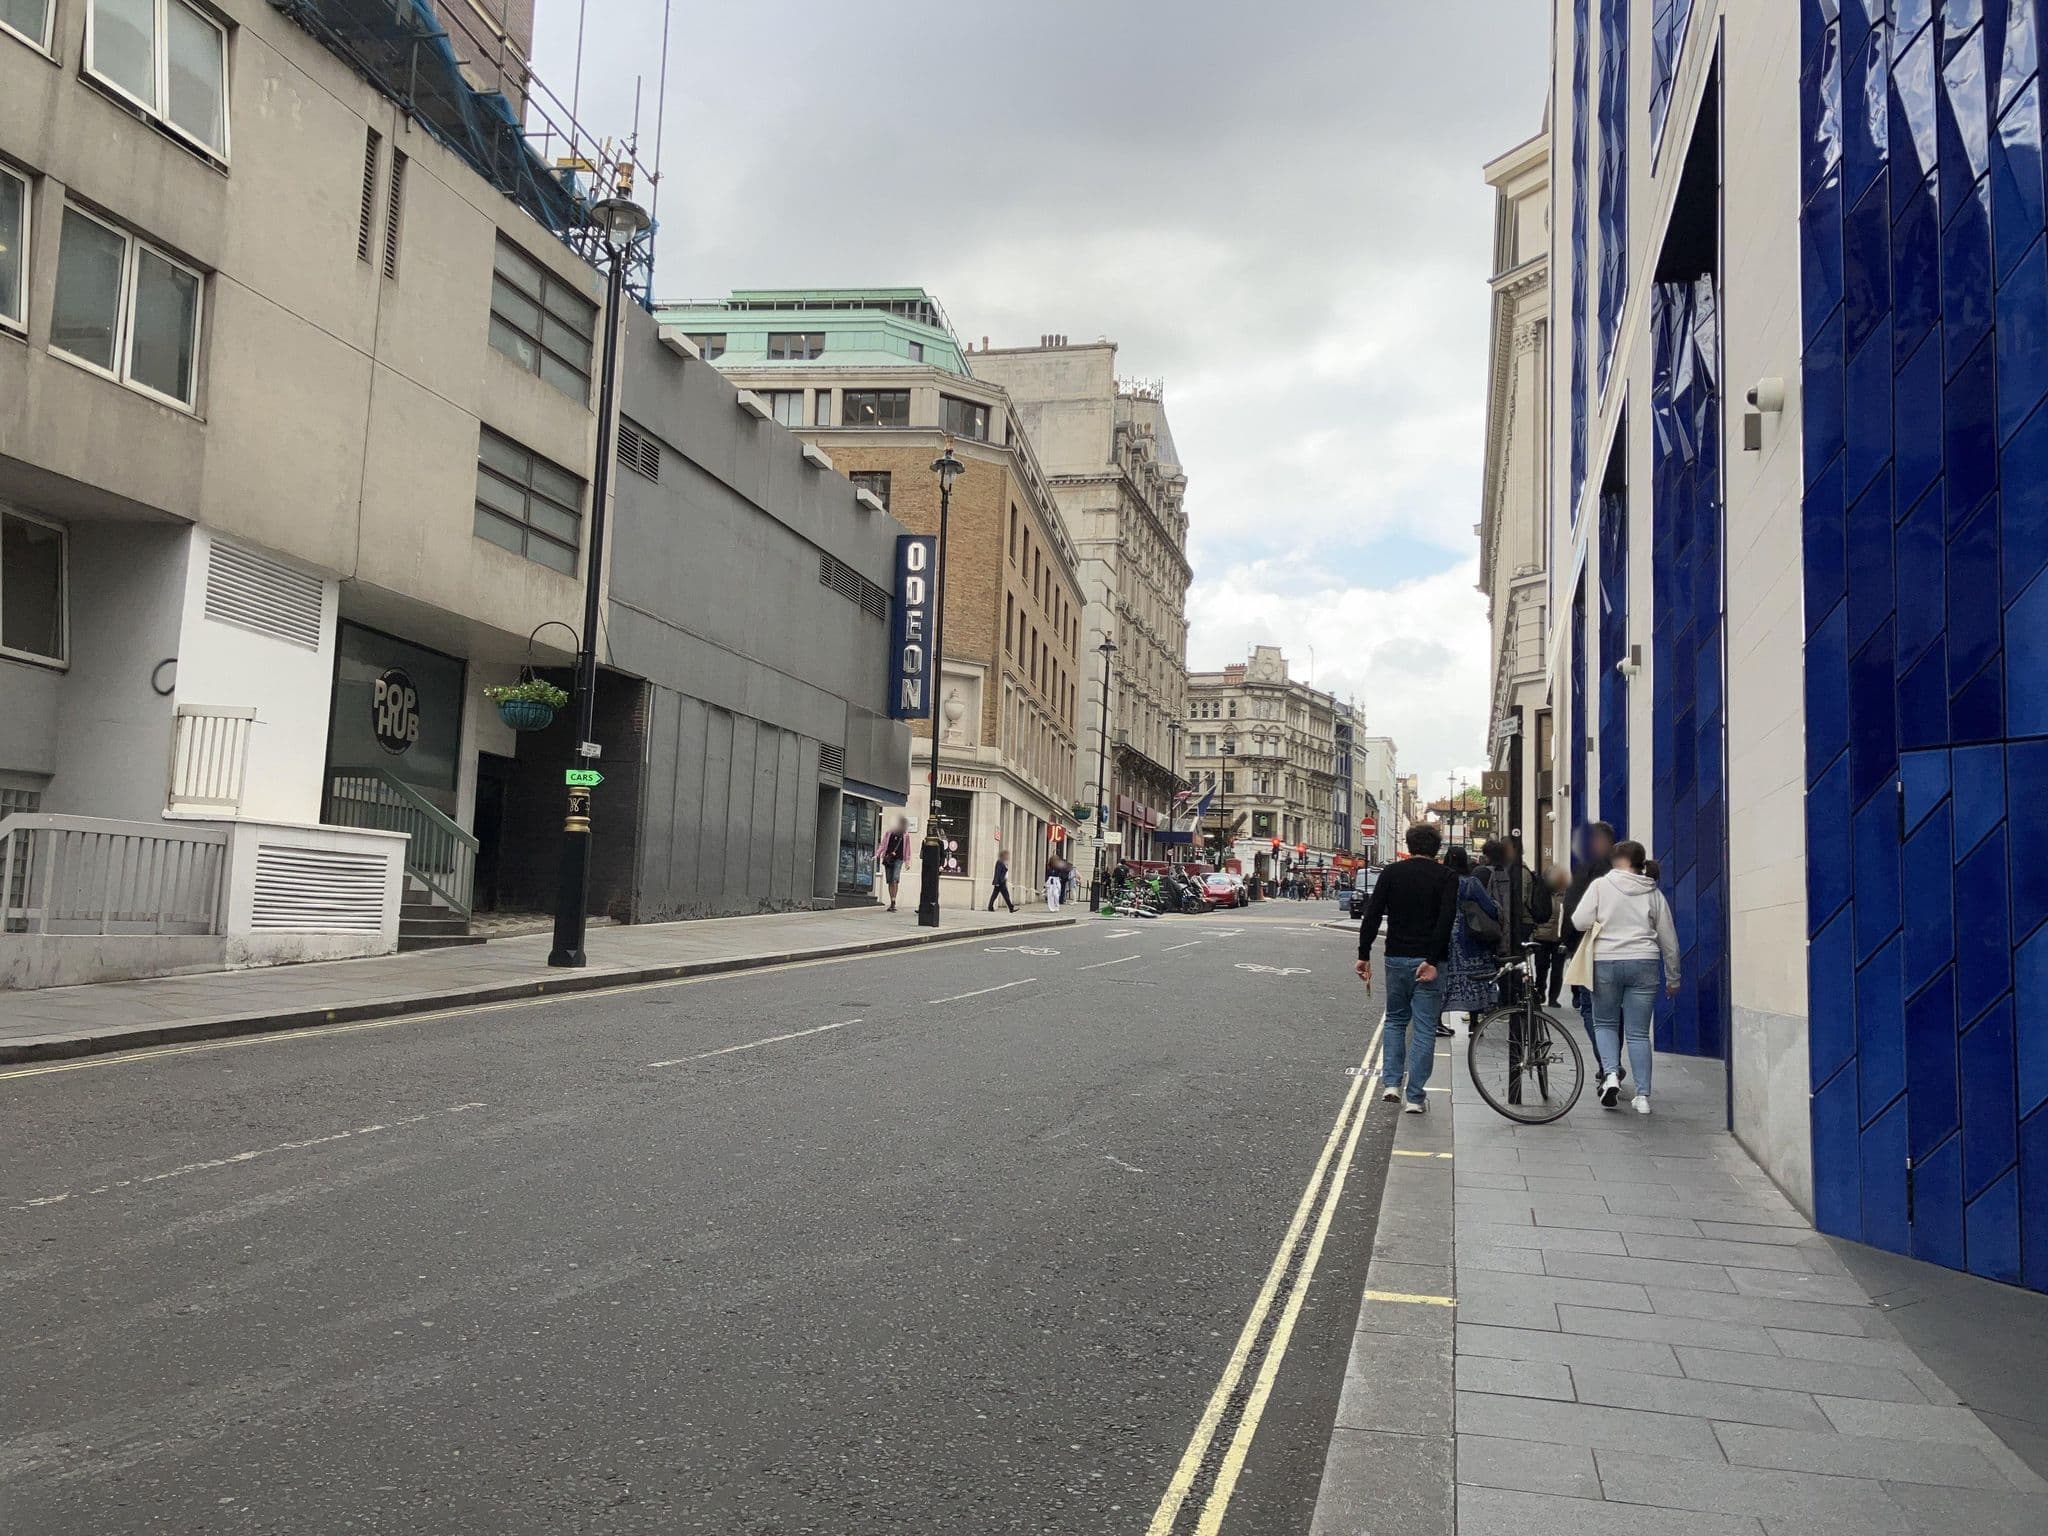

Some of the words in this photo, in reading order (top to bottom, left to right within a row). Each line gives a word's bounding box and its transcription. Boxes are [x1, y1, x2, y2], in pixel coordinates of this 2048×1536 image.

[901, 541, 927, 710] ODEON
[374, 679, 416, 709] POP
[378, 705, 420, 741] HUB
[570, 773, 594, 782] CARS
[940, 773, 961, 785] JAPAN
[963, 776, 987, 789] CENTRE
[1050, 825, 1062, 842] JC
